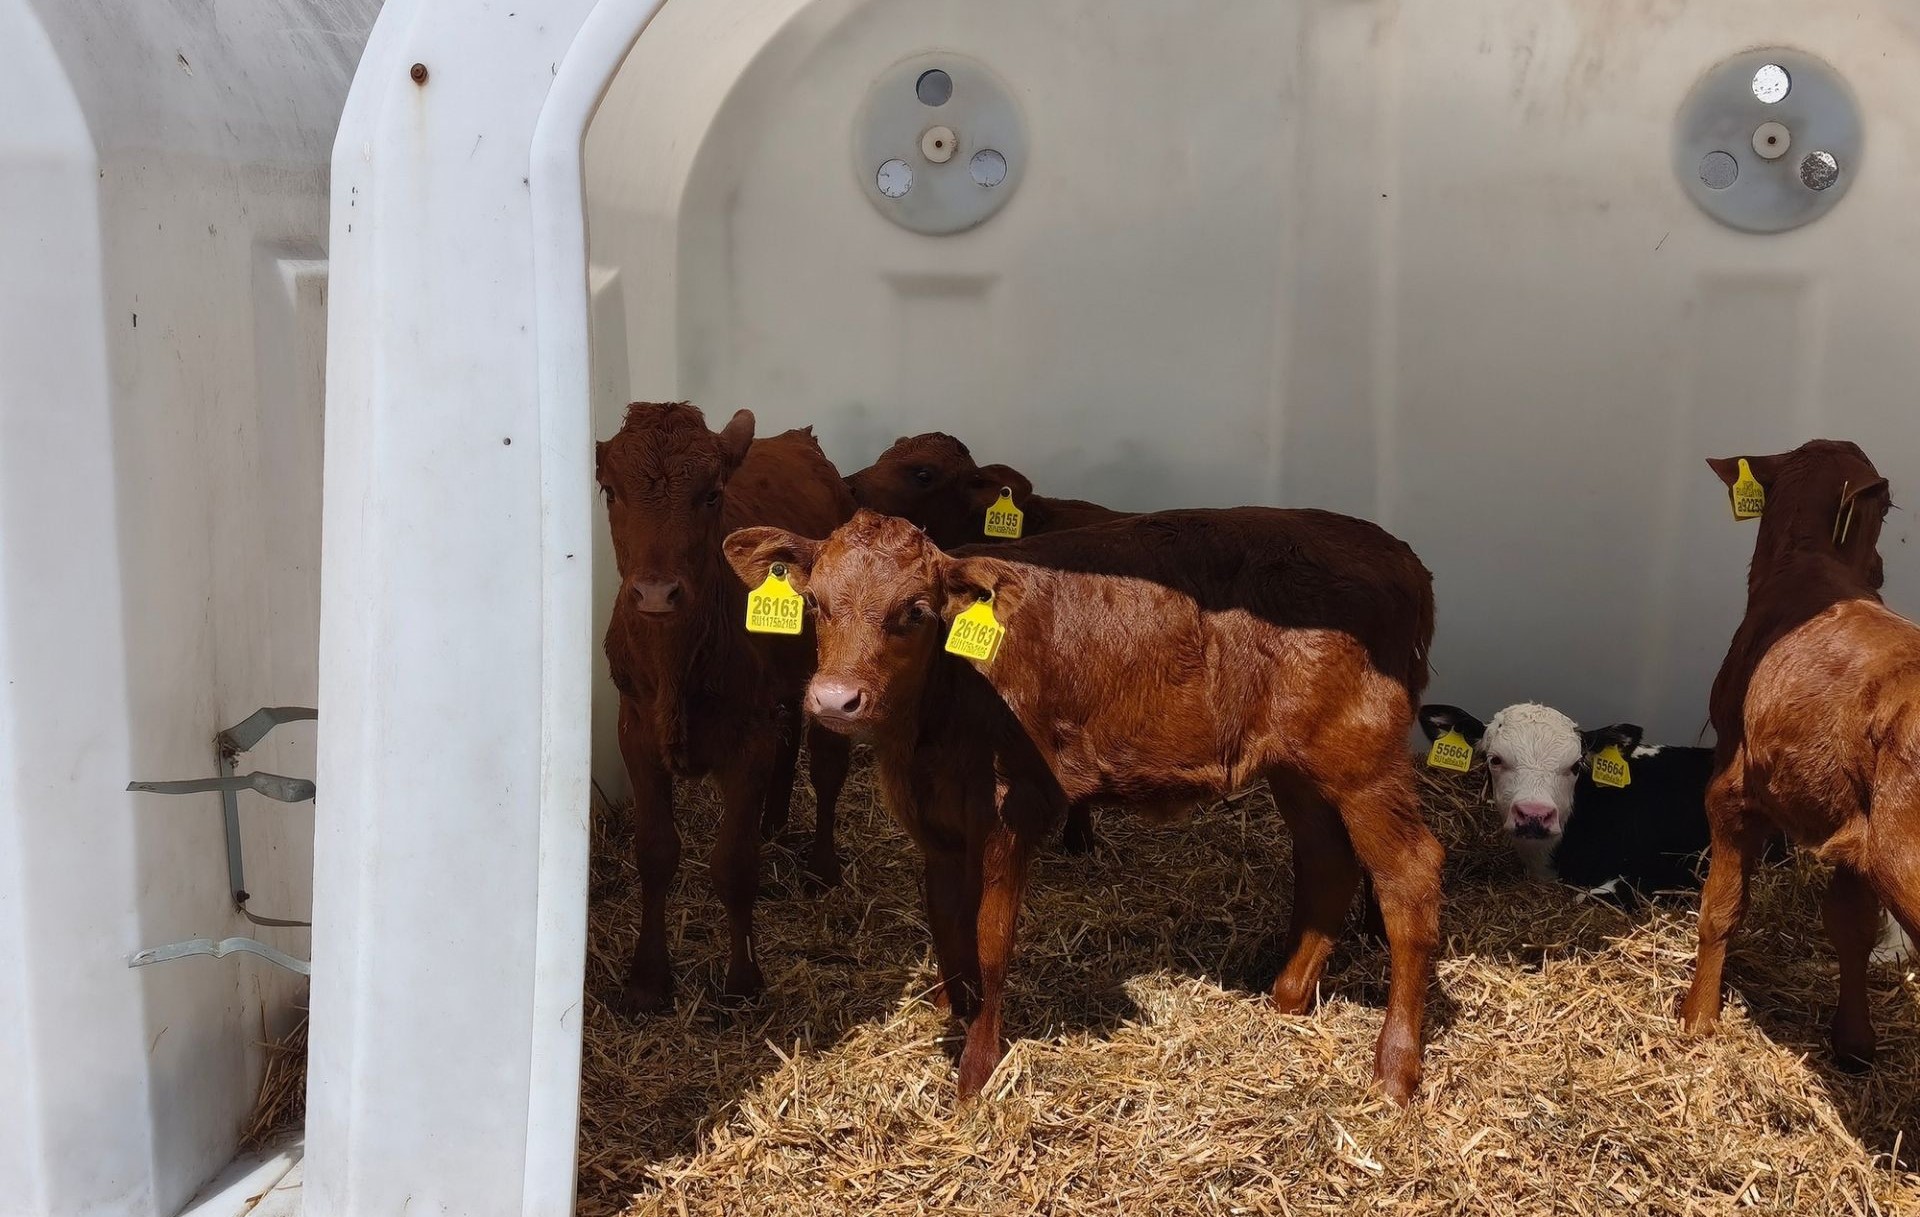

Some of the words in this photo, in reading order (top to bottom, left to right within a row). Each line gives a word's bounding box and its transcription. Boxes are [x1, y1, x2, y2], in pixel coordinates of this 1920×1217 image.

[988, 511, 1018, 527] 26155
[752, 595, 799, 618] 26163
[954, 618, 996, 646] 26163
[1436, 743, 1469, 760] 55664
[1596, 758, 1624, 777] 55664
